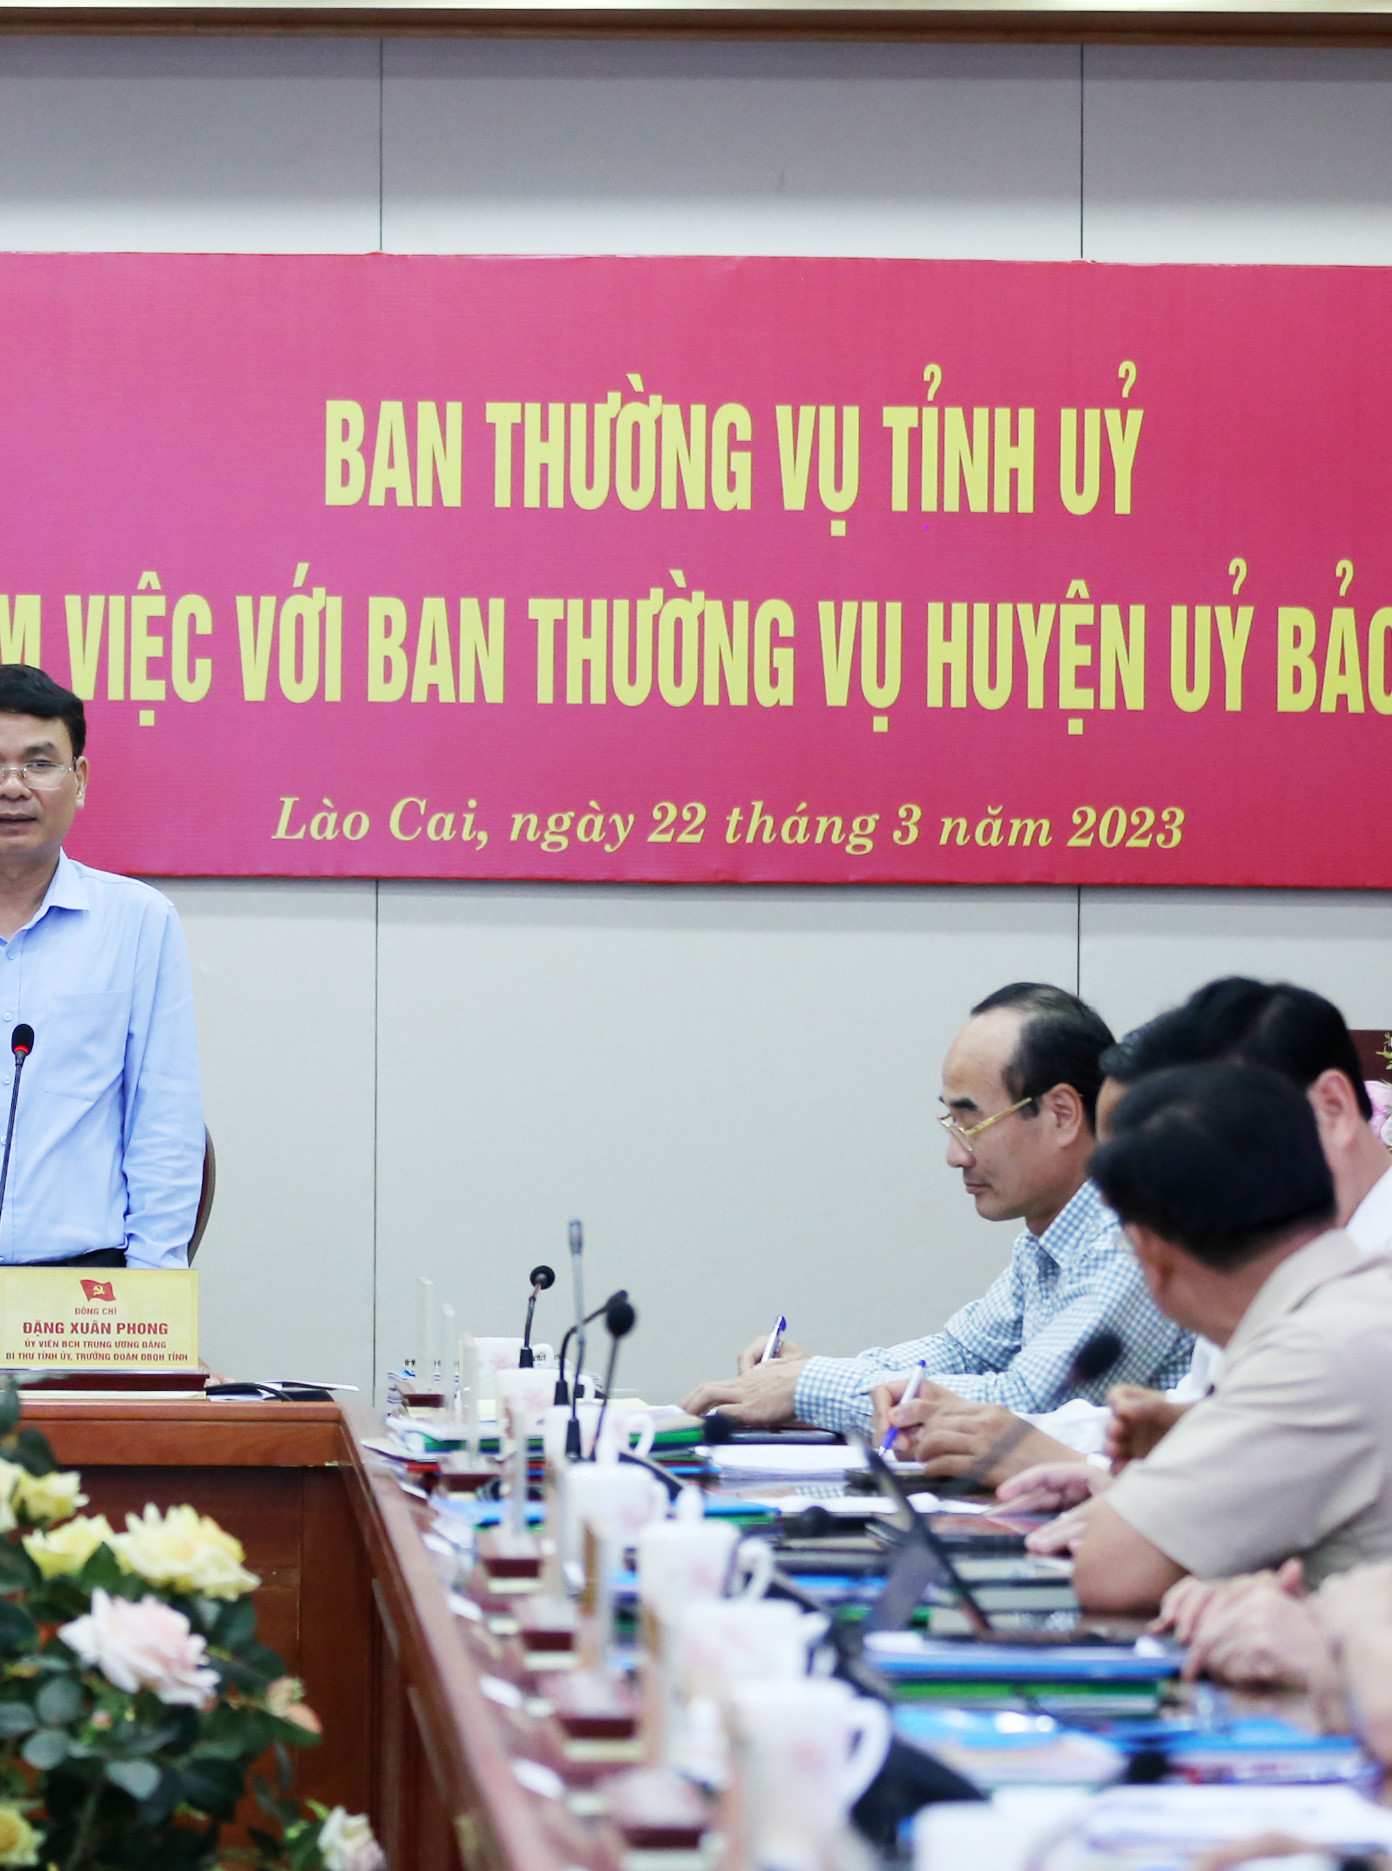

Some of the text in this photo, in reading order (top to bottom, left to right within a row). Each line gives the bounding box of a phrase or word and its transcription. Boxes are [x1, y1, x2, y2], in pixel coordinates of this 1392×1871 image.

[325, 360, 1145, 537] BAN THƯỜNG VỤ TỈNH UỶ
[64, 570, 214, 727] VIỆC
[235, 561, 343, 704] VỚI
[367, 596, 506, 704] BAN
[527, 569, 795, 708] THƯỜNG
[818, 600, 903, 733] VỤ
[926, 579, 1146, 735] HUYỆN
[1170, 557, 1255, 713] UỶ
[272, 797, 1185, 855] Lào Cai, ngày 22 tháng 3 năm 2023
[23, 1319, 168, 1337] ĐẶNG XUÂN PHONG
[39, 1339, 59, 1348] VIÊN
[83, 1341, 112, 1349] TRUNG
[18, 1352, 35, 1360] THƯ
